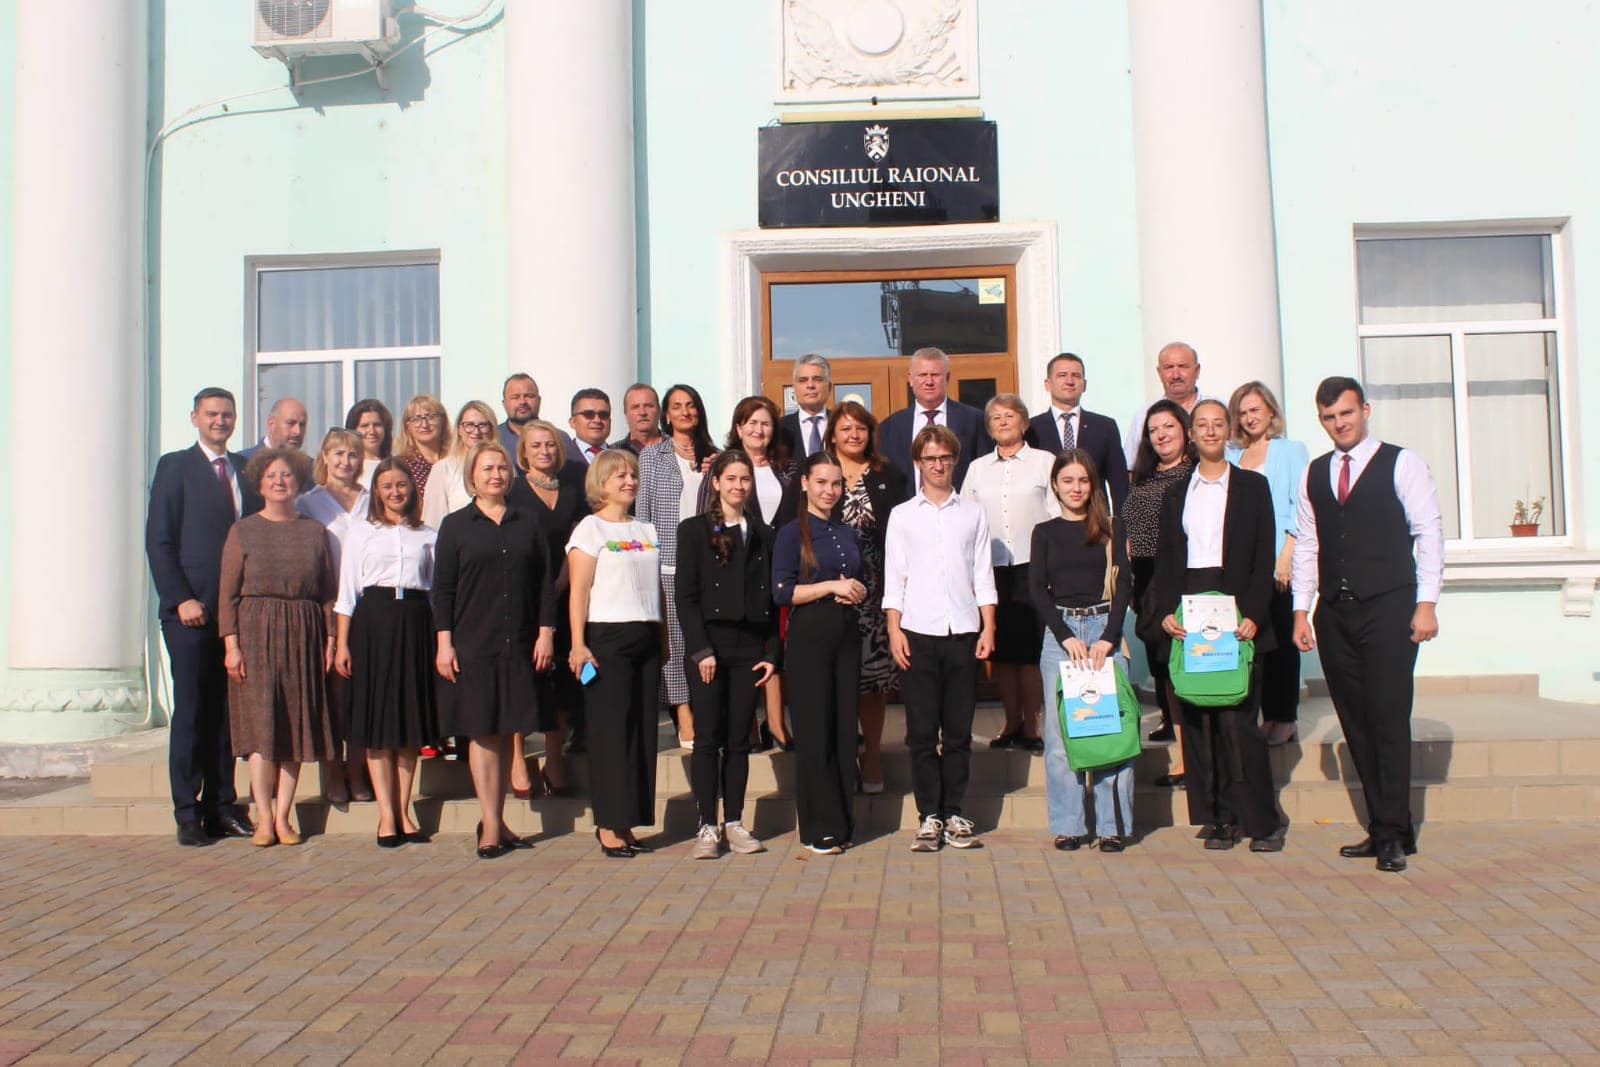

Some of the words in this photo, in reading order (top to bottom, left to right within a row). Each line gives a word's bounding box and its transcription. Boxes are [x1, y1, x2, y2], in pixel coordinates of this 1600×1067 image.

[776, 168, 883, 187] CONSILIUL
[888, 166, 980, 183] RAIONAL
[831, 191, 926, 208] UNGHENI
